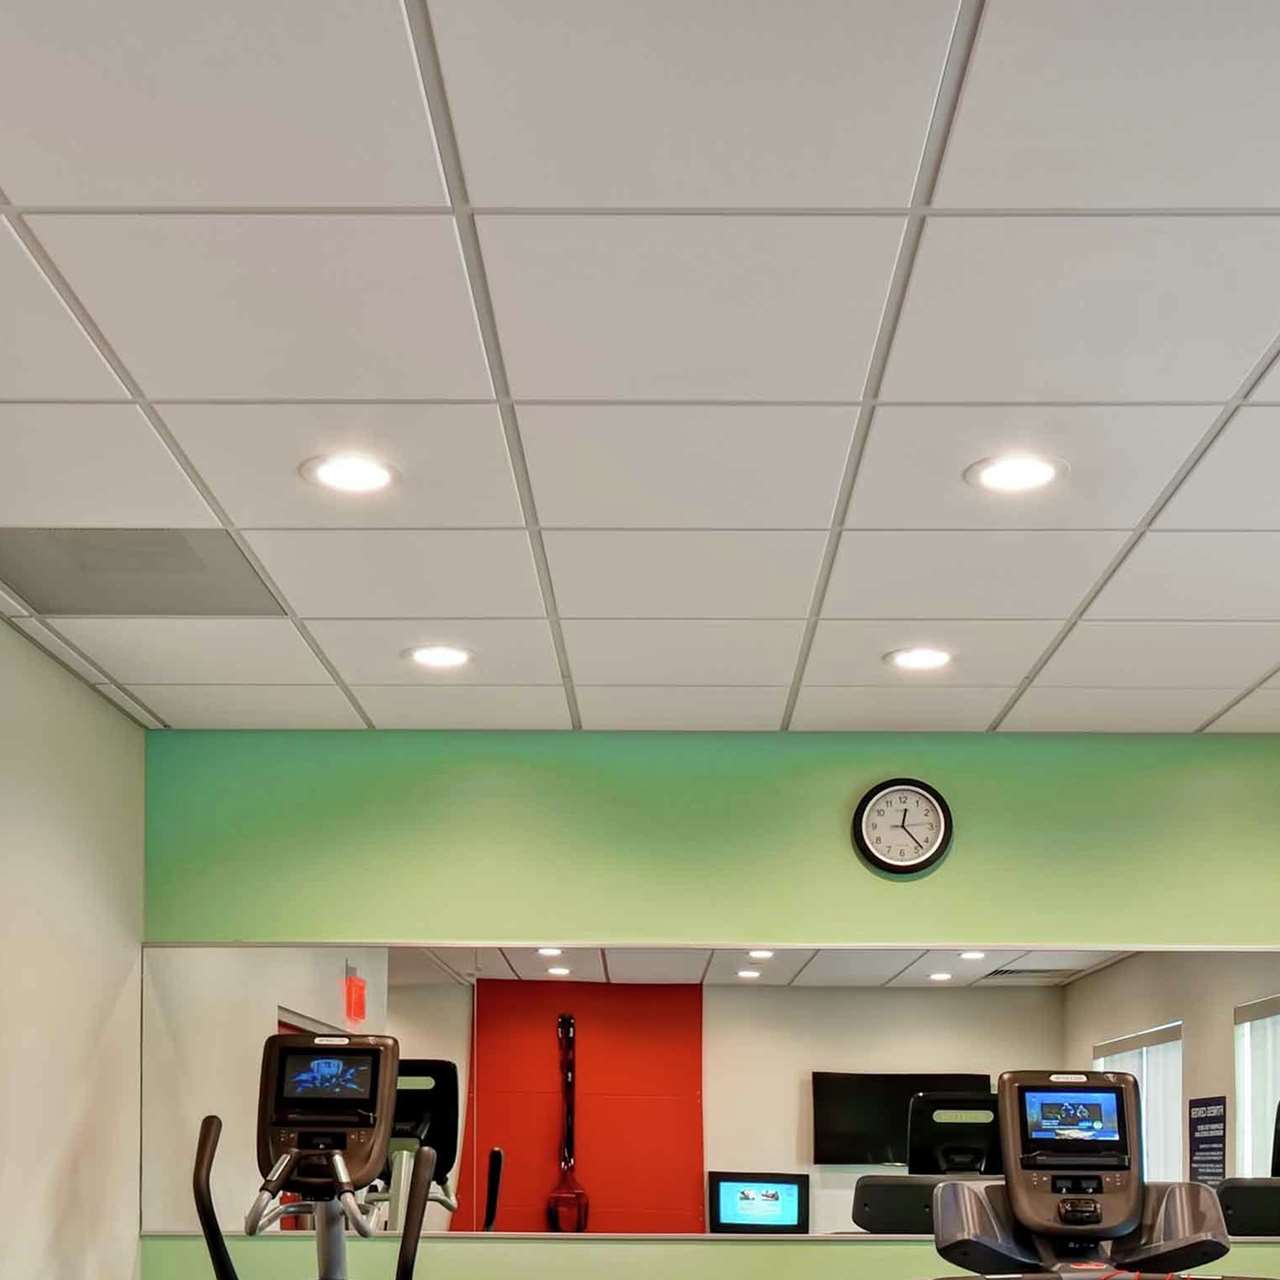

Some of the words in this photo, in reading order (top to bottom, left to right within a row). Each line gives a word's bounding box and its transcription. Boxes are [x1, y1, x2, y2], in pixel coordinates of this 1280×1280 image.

[886, 800, 893, 808] 11
[899, 796, 908, 804] 12
[877, 809, 885, 817] 10
[928, 823, 934, 831] 3
